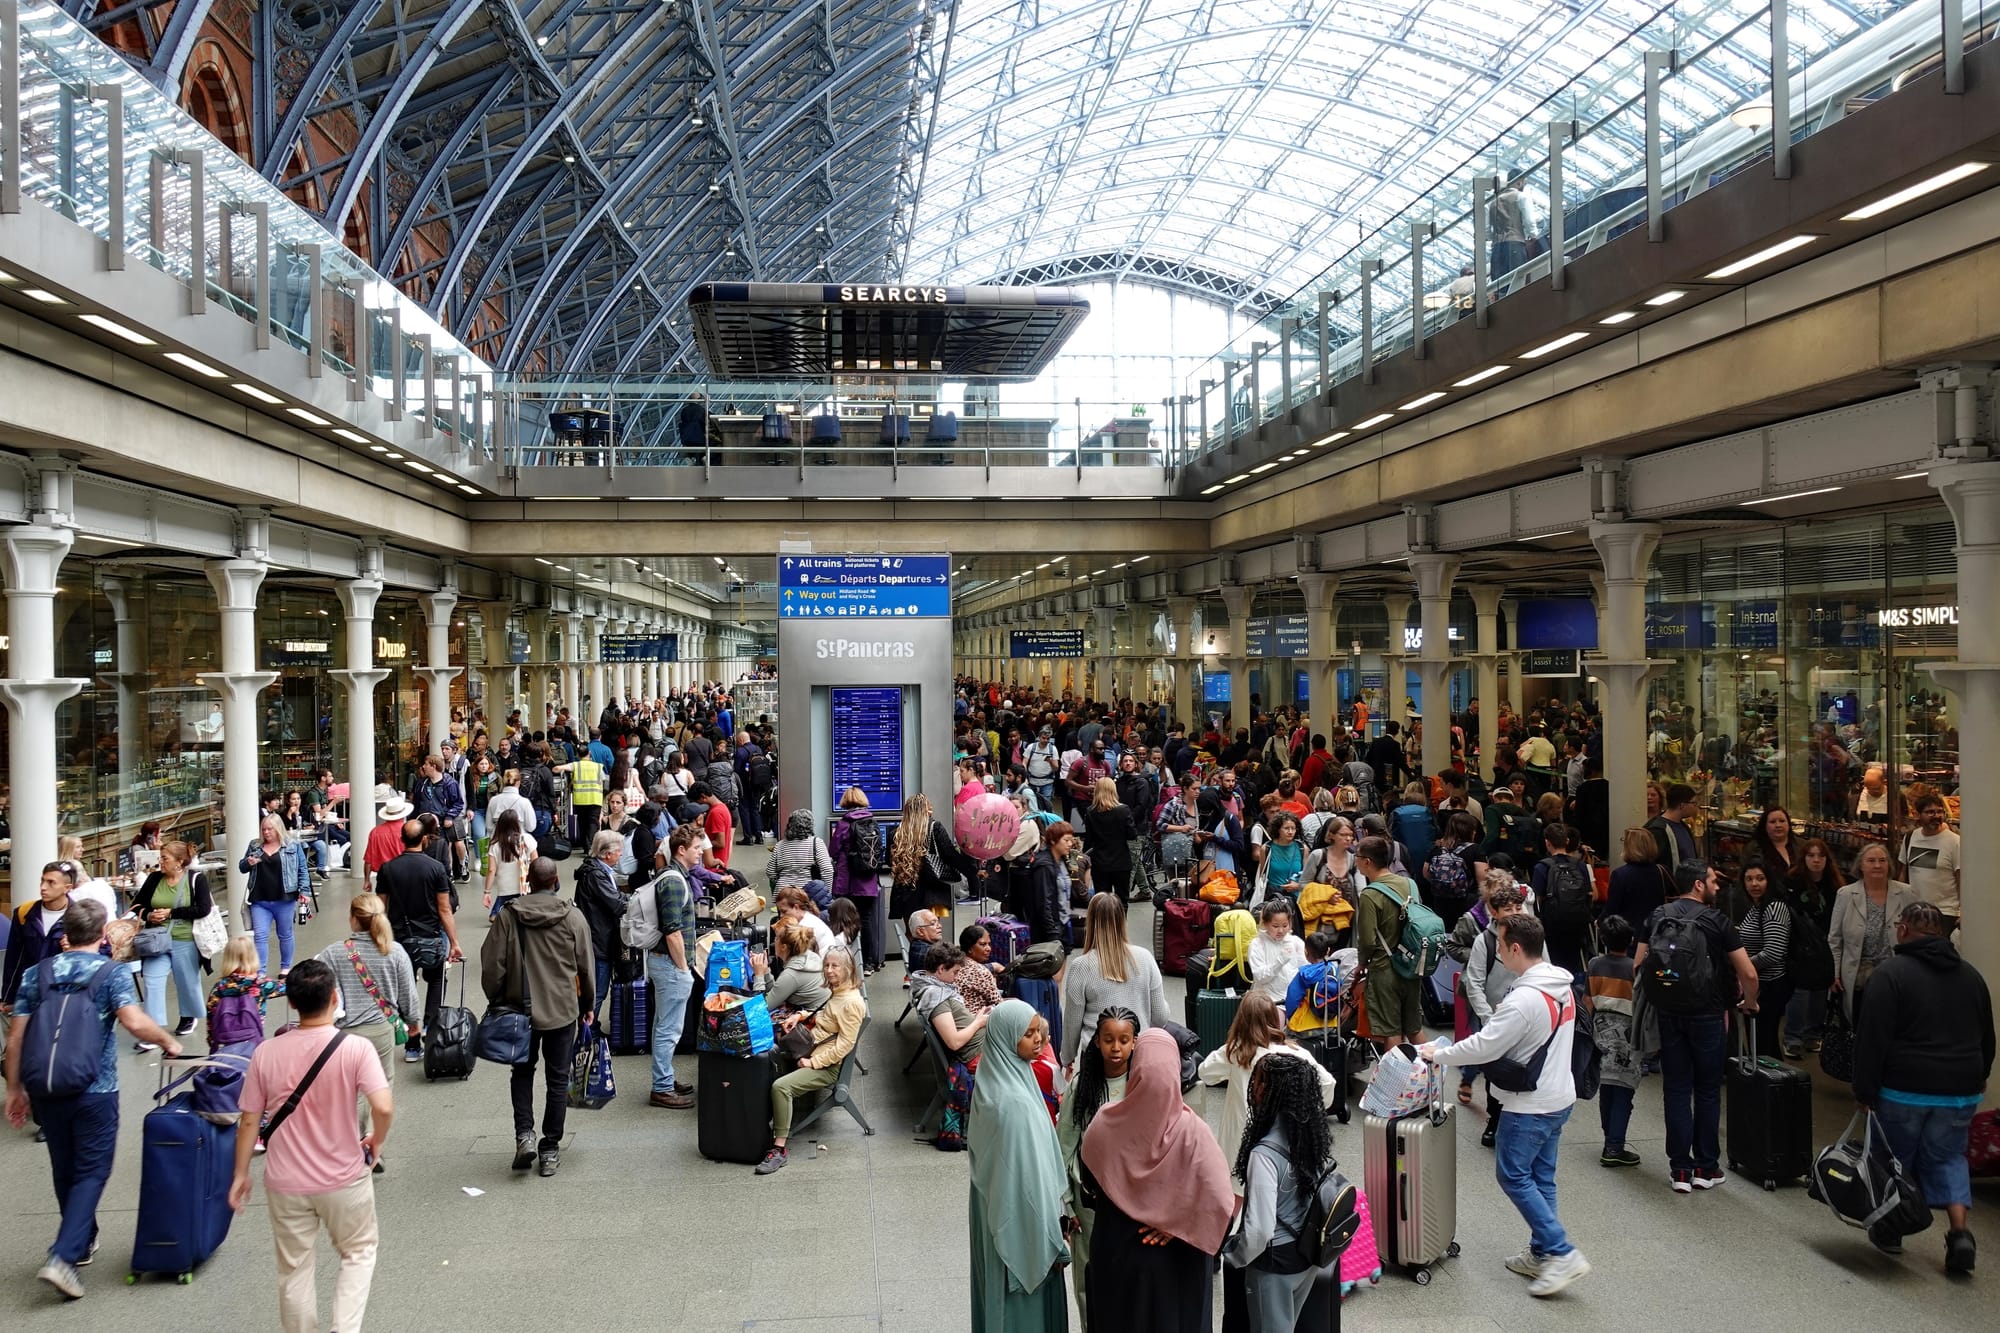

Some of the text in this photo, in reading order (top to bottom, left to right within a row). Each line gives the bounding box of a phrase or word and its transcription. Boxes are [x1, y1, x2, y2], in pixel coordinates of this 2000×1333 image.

[841, 287, 947, 302] SEARCYS
[799, 559, 842, 568] All trains
[840, 574, 877, 585] Départs
[879, 574, 932, 585] Departures
[799, 590, 836, 600] Way out
[1807, 606, 1865, 622] Departes
[1878, 606, 1959, 627] M&S SIMPL
[1650, 625, 1687, 636] EROSTAR
[378, 637, 406, 658] Dune
[970, 807, 1014, 833] Happy
